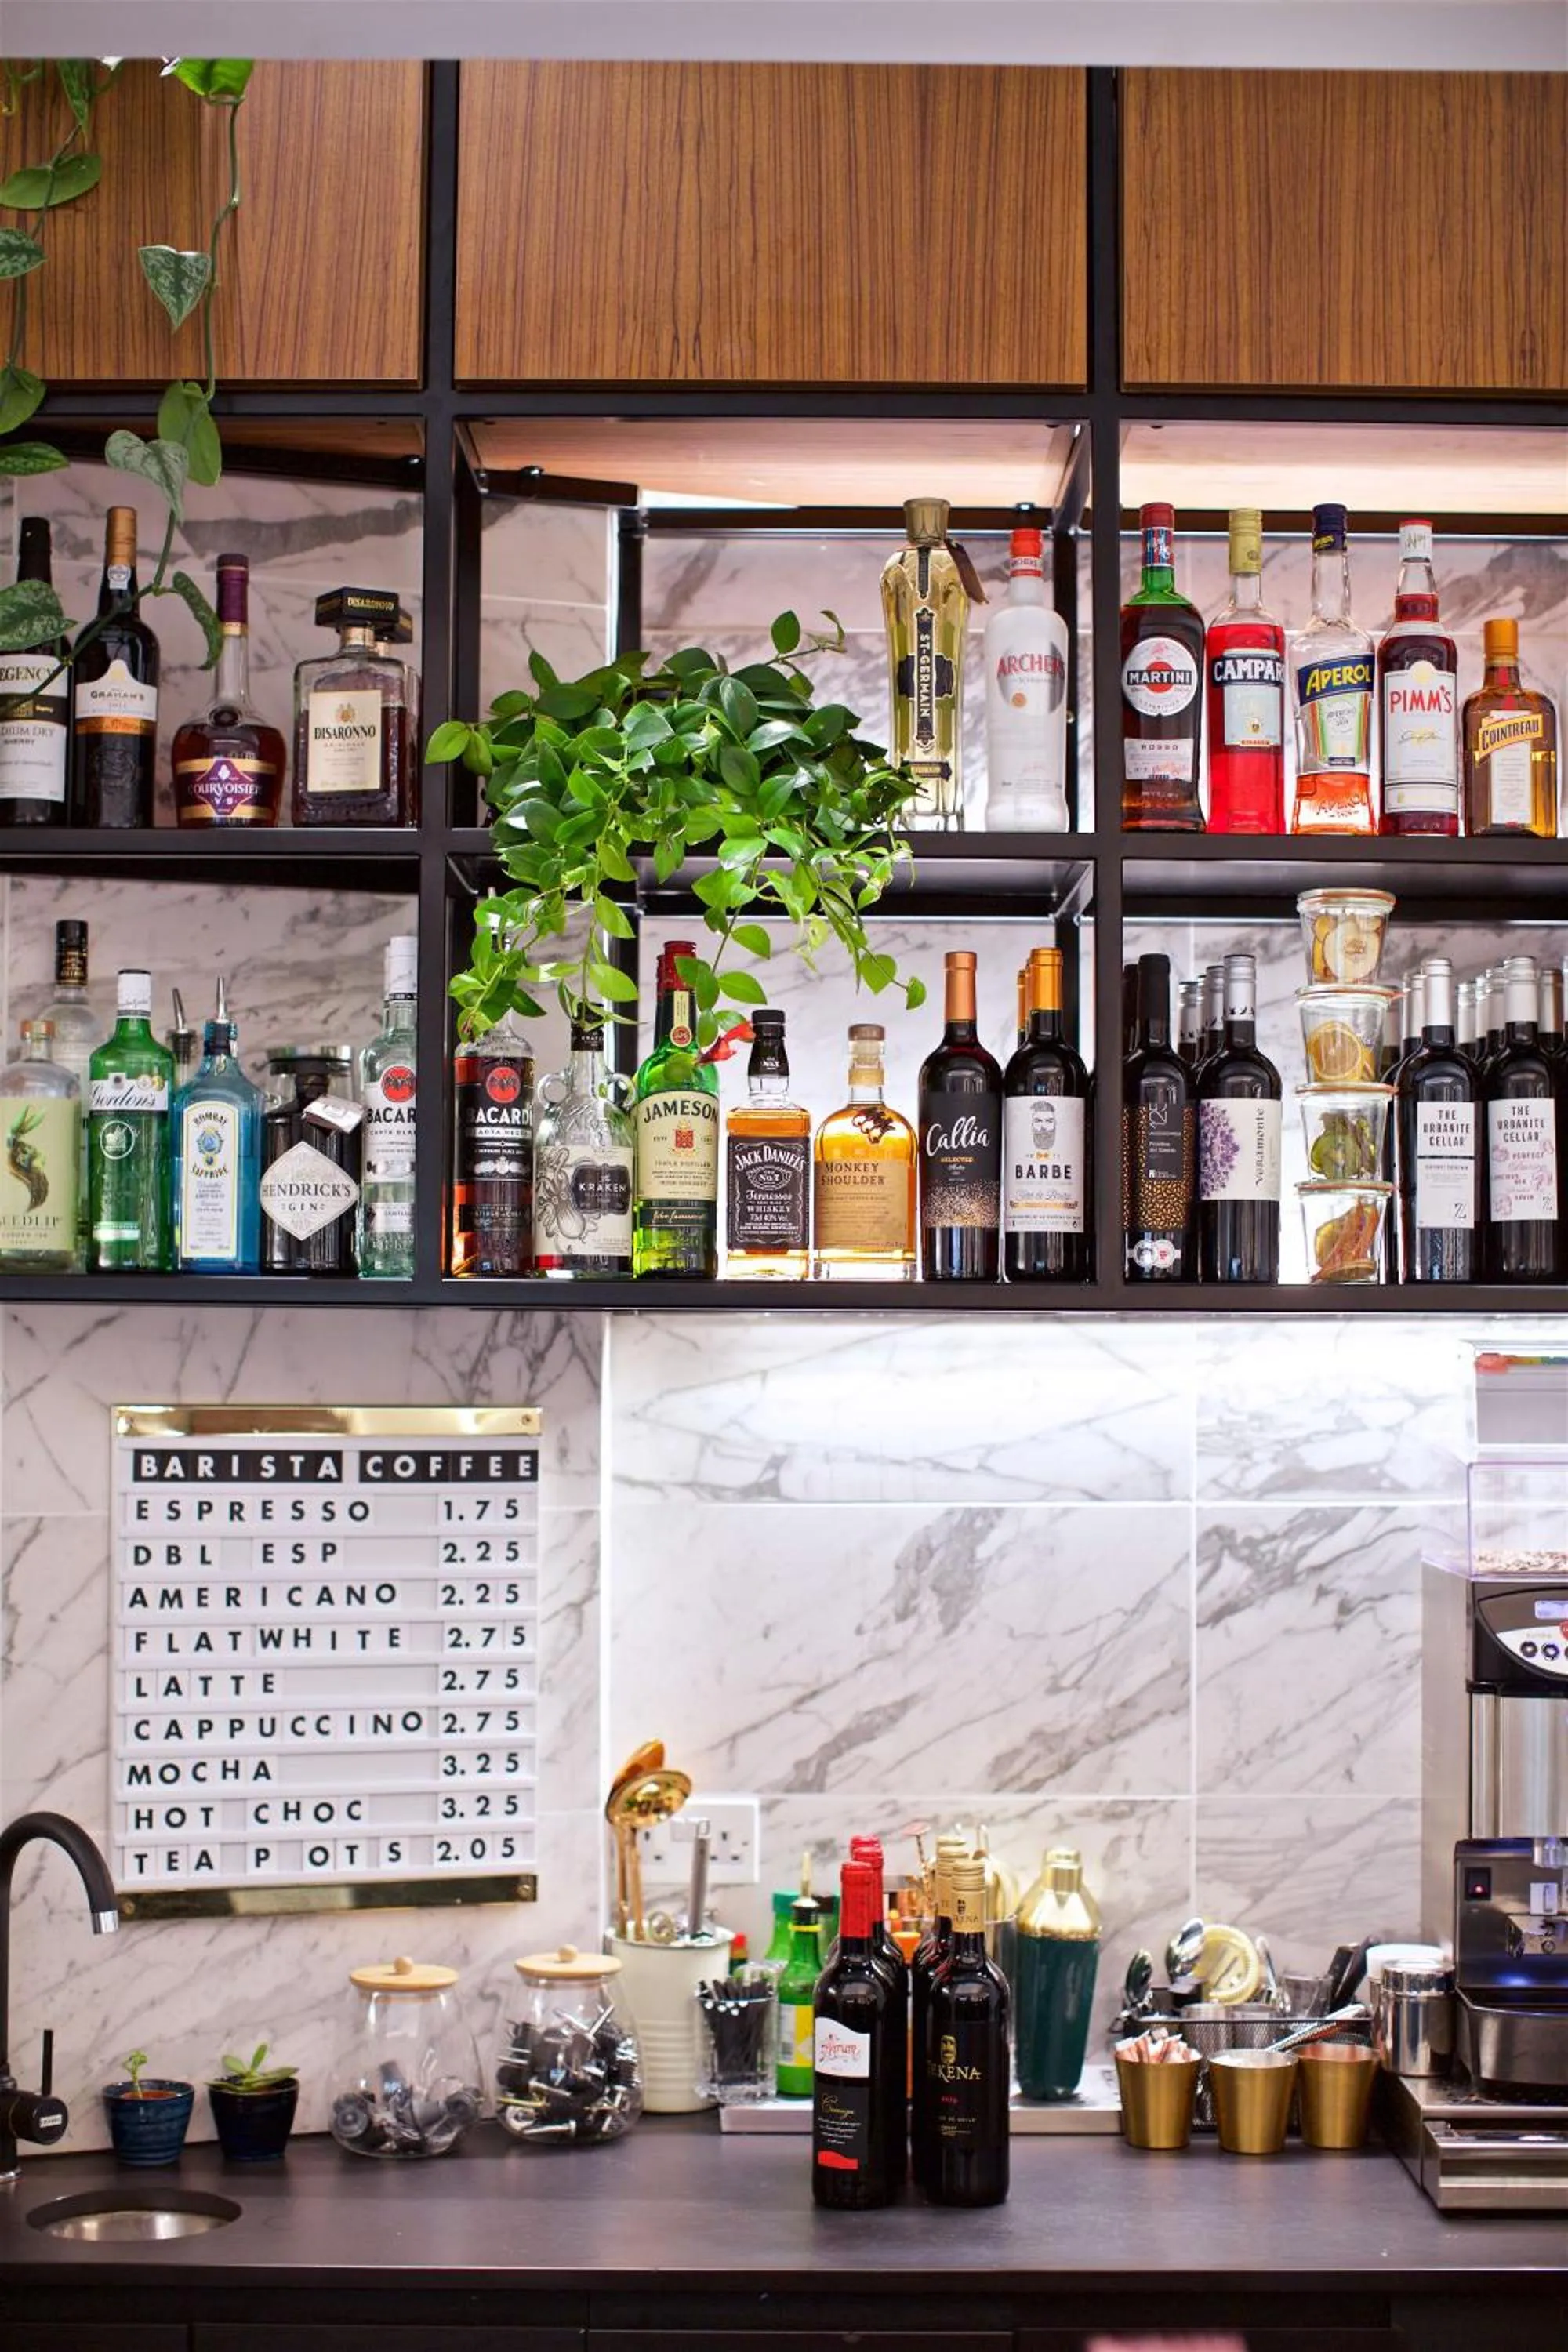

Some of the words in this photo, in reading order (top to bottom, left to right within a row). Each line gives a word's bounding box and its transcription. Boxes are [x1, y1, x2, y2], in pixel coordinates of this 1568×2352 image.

[919, 633, 931, 717] ST-GERMAIN
[997, 654, 1065, 679] ARCHERS
[1129, 670, 1192, 684] MARTINI
[1306, 665, 1371, 696] APEROL
[1390, 685, 1453, 714] PIMM'S
[314, 724, 376, 741] DISARONNO
[1482, 720, 1539, 751] COINTREAU
[193, 1112, 228, 1127] BOMBAY
[644, 1099, 718, 1123] JAMESON
[1438, 1109, 1456, 1120] THE
[1512, 1105, 1530, 1116] THE
[926, 1116, 990, 1156] Callia
[1429, 1136, 1465, 1146] CELLAR
[1503, 1131, 1539, 1142] CELLAR
[735, 1149, 762, 1171] JACK
[764, 1145, 807, 1172] DANIEL'S
[825, 1163, 879, 1172] MONKEY
[821, 1175, 885, 1185] SHOULDER
[1015, 1164, 1072, 1179] BARBE
[263, 1183, 351, 1197] HENDRICK'S
[579, 1183, 626, 1192] KRAKEN
[289, 1203, 318, 1211] GIN
[0, 1216, 63, 1227] EEDLIP
[140, 1455, 338, 1479] BARISTA
[366, 1454, 532, 1479] COFFEE
[136, 1499, 369, 1523] ESPRESSO
[444, 1498, 519, 1521] 1.75
[133, 1544, 212, 1565] DBL
[262, 1543, 338, 1564] ESP
[443, 1541, 519, 1563] 2.25
[129, 1583, 397, 1610] AMERICANO
[442, 1582, 520, 1606] 2.25
[448, 1626, 526, 1649] 2.75
[136, 1672, 274, 1698] LATTE
[442, 1668, 519, 1692] 2.75
[134, 1711, 423, 1740] CAPPUCCINO
[443, 1711, 520, 1733] 2.75
[127, 1759, 272, 1786] MOCHA
[443, 1752, 520, 1776] 3.25
[135, 1806, 214, 1831] HOT
[254, 1800, 362, 1824] CHOC
[441, 1795, 519, 1819] 3.25
[134, 1849, 214, 1875] TEA
[437, 1838, 515, 1862] 2.05
